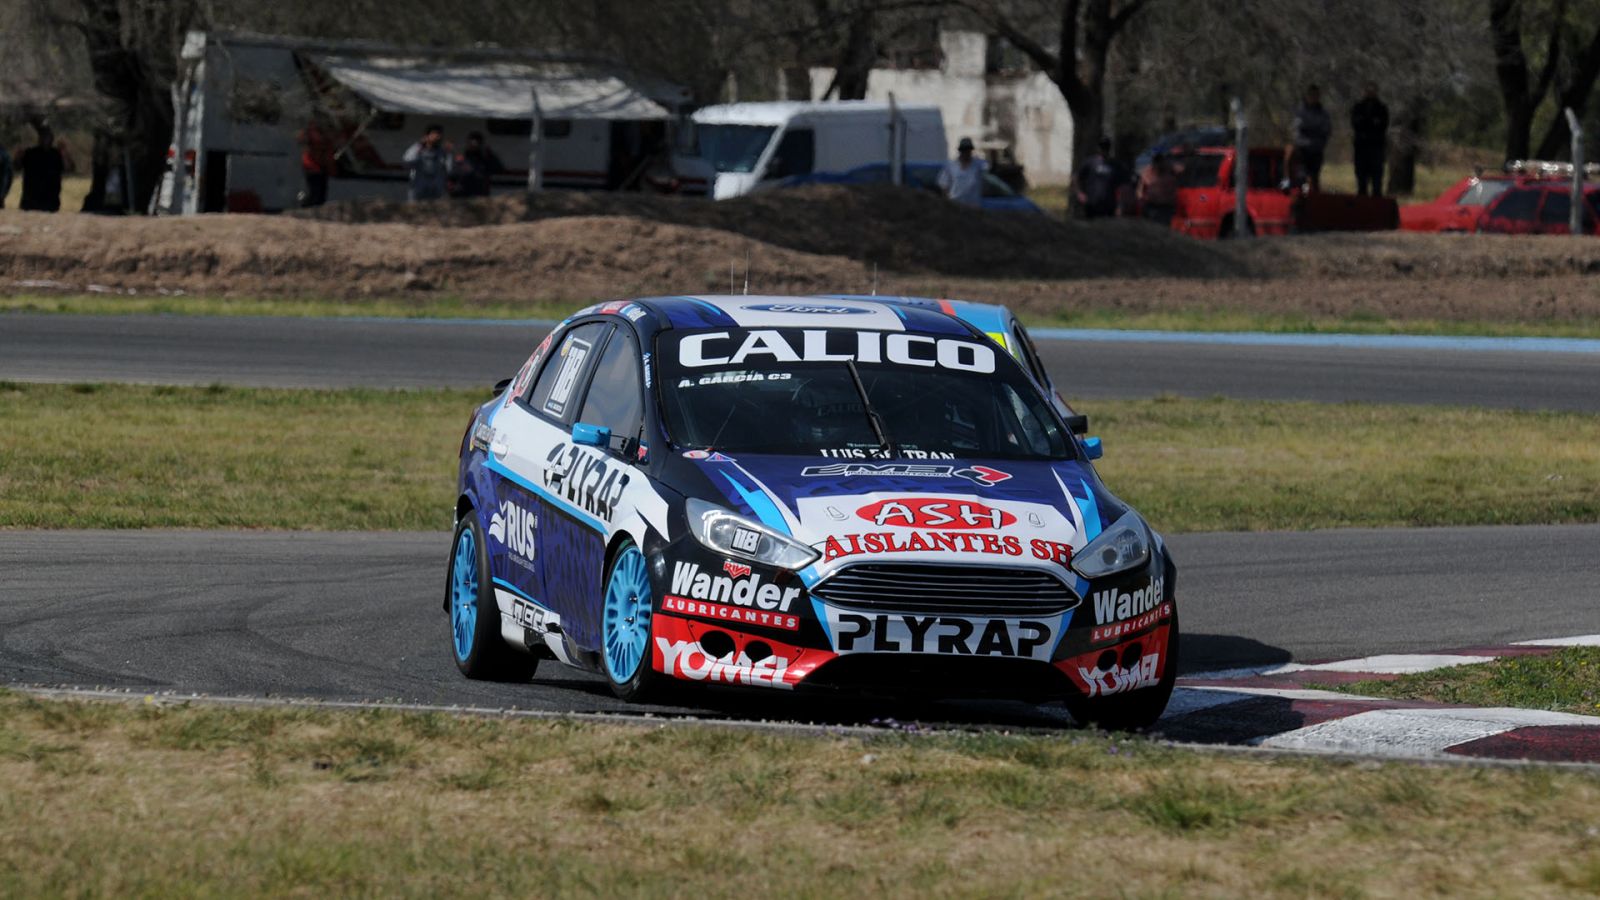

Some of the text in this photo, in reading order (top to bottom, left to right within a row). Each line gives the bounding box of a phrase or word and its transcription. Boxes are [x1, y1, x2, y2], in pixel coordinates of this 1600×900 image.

[769, 304, 849, 314] Ford
[679, 330, 995, 373] CALICO
[506, 500, 535, 561] RUS
[875, 502, 1002, 529] ASH
[735, 528, 760, 551] 118
[824, 531, 1074, 571] AISLANTES SH
[671, 561, 800, 611] Wander
[724, 561, 750, 576] RIVA
[666, 598, 796, 628] LUBRICANTES
[1093, 575, 1165, 625] Wander
[838, 614, 1051, 657] PLYRAP
[1094, 604, 1170, 640] LUBRICANTES
[655, 637, 794, 690] YOMEL
[1079, 653, 1160, 698] YOMEL
